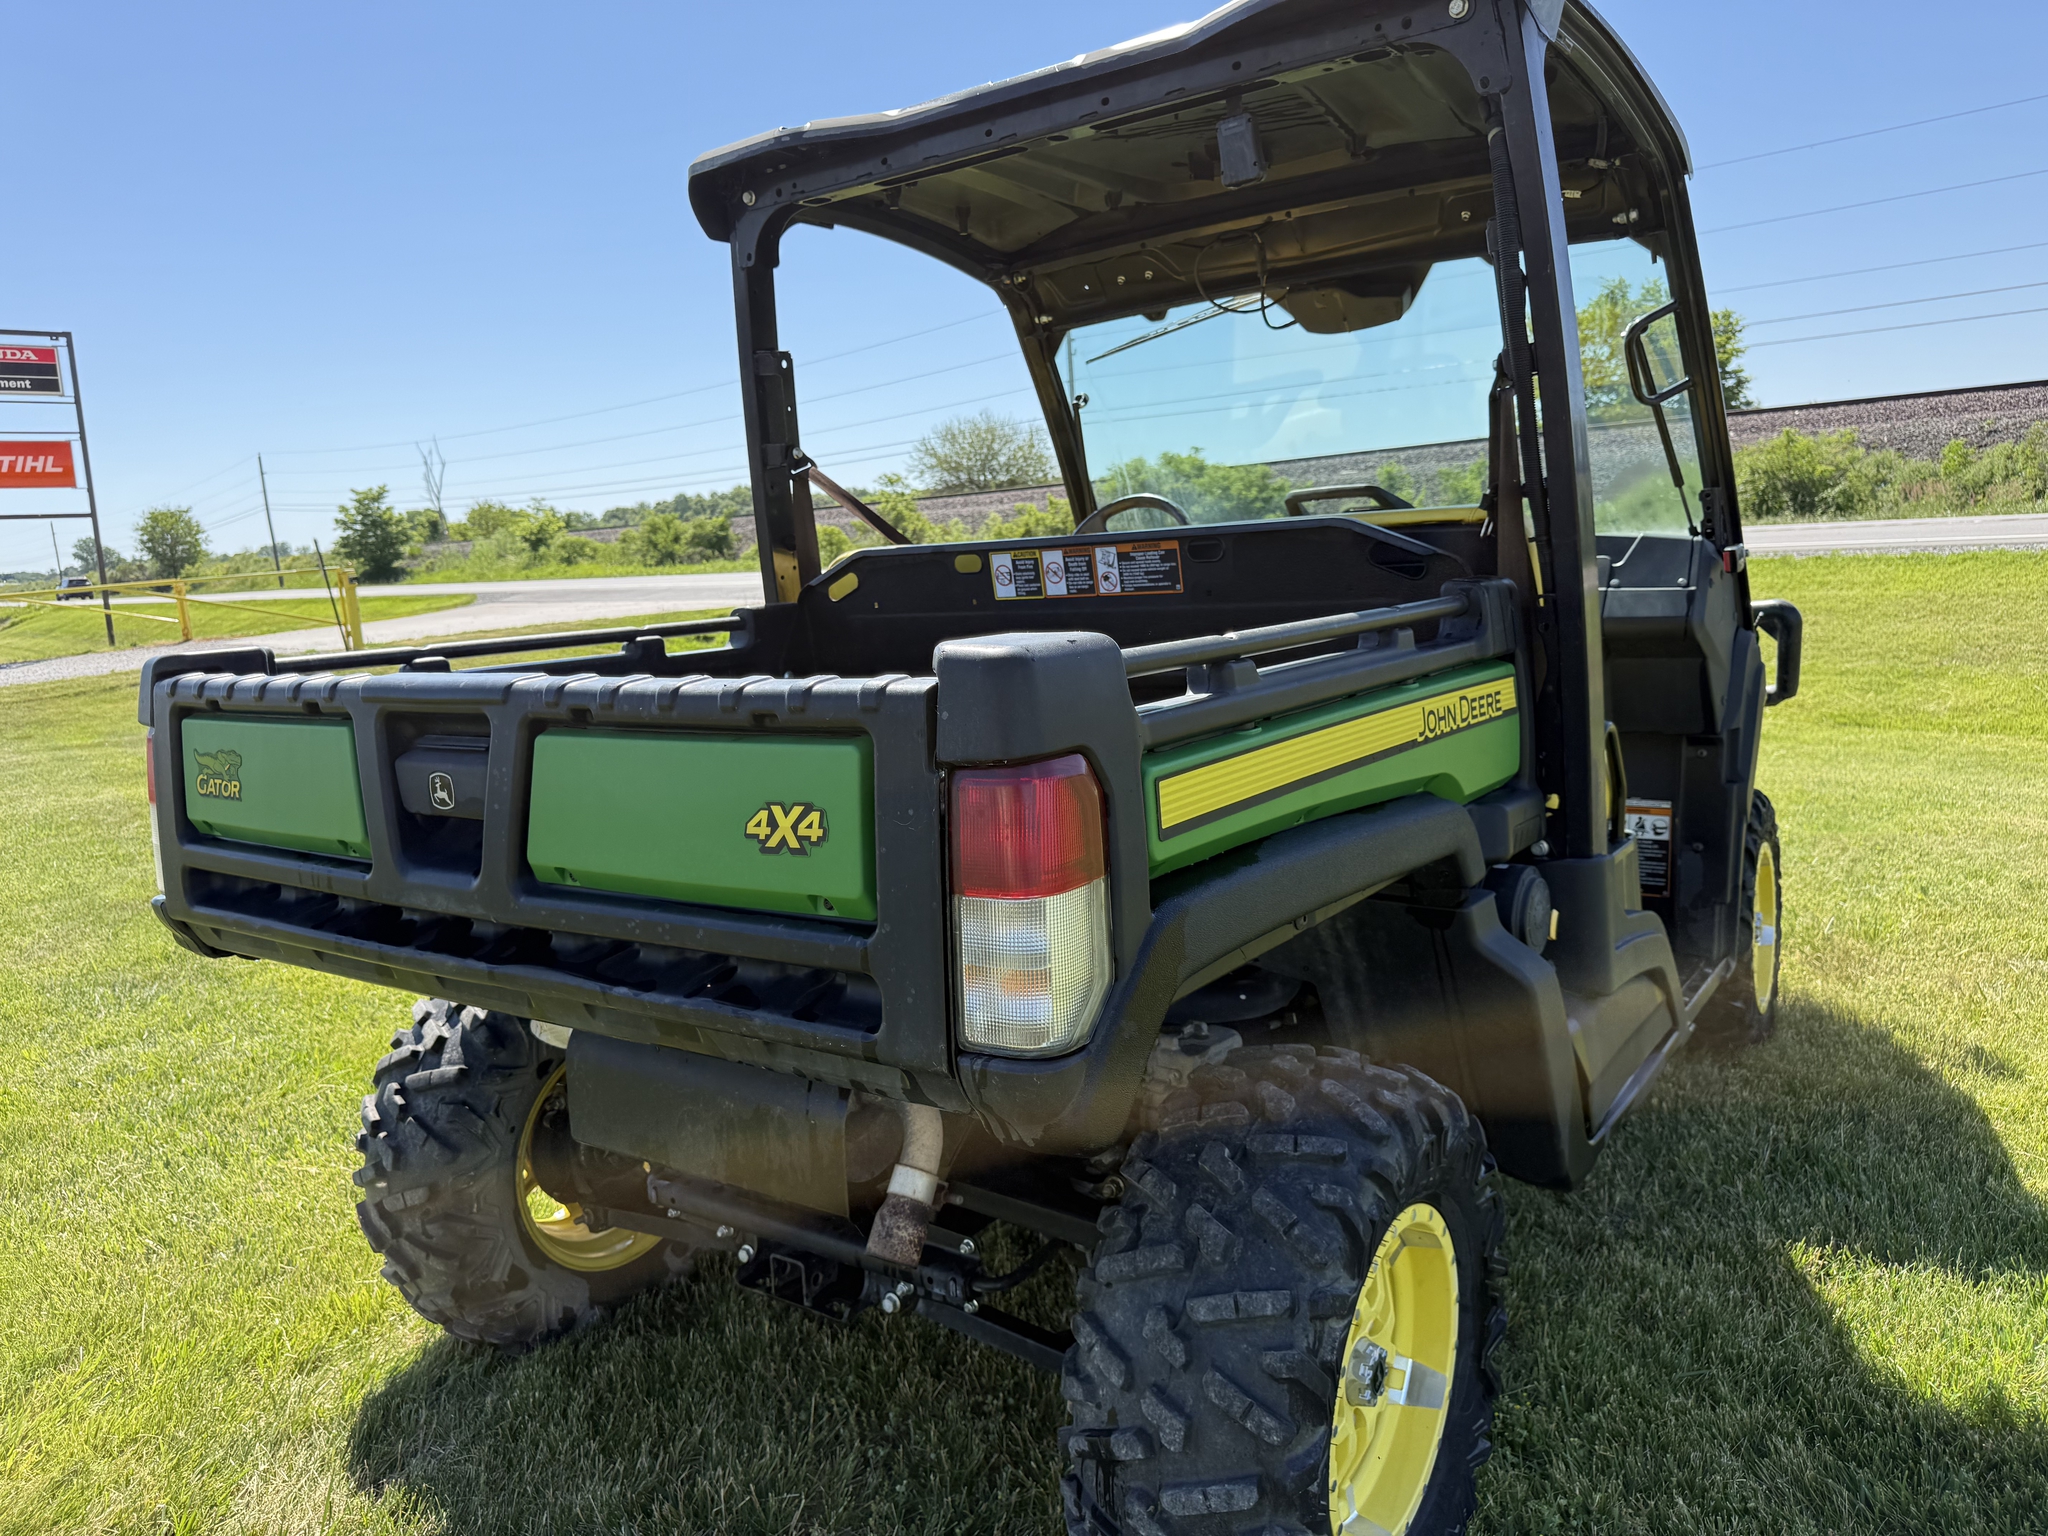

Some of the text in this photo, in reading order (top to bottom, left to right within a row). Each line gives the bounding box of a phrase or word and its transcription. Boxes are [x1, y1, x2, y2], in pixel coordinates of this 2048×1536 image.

[0, 349, 39, 360] DA
[1418, 690, 1502, 738] JOHN DEERE
[196, 773, 240, 798] GATOR
[745, 804, 825, 850] 4X4
